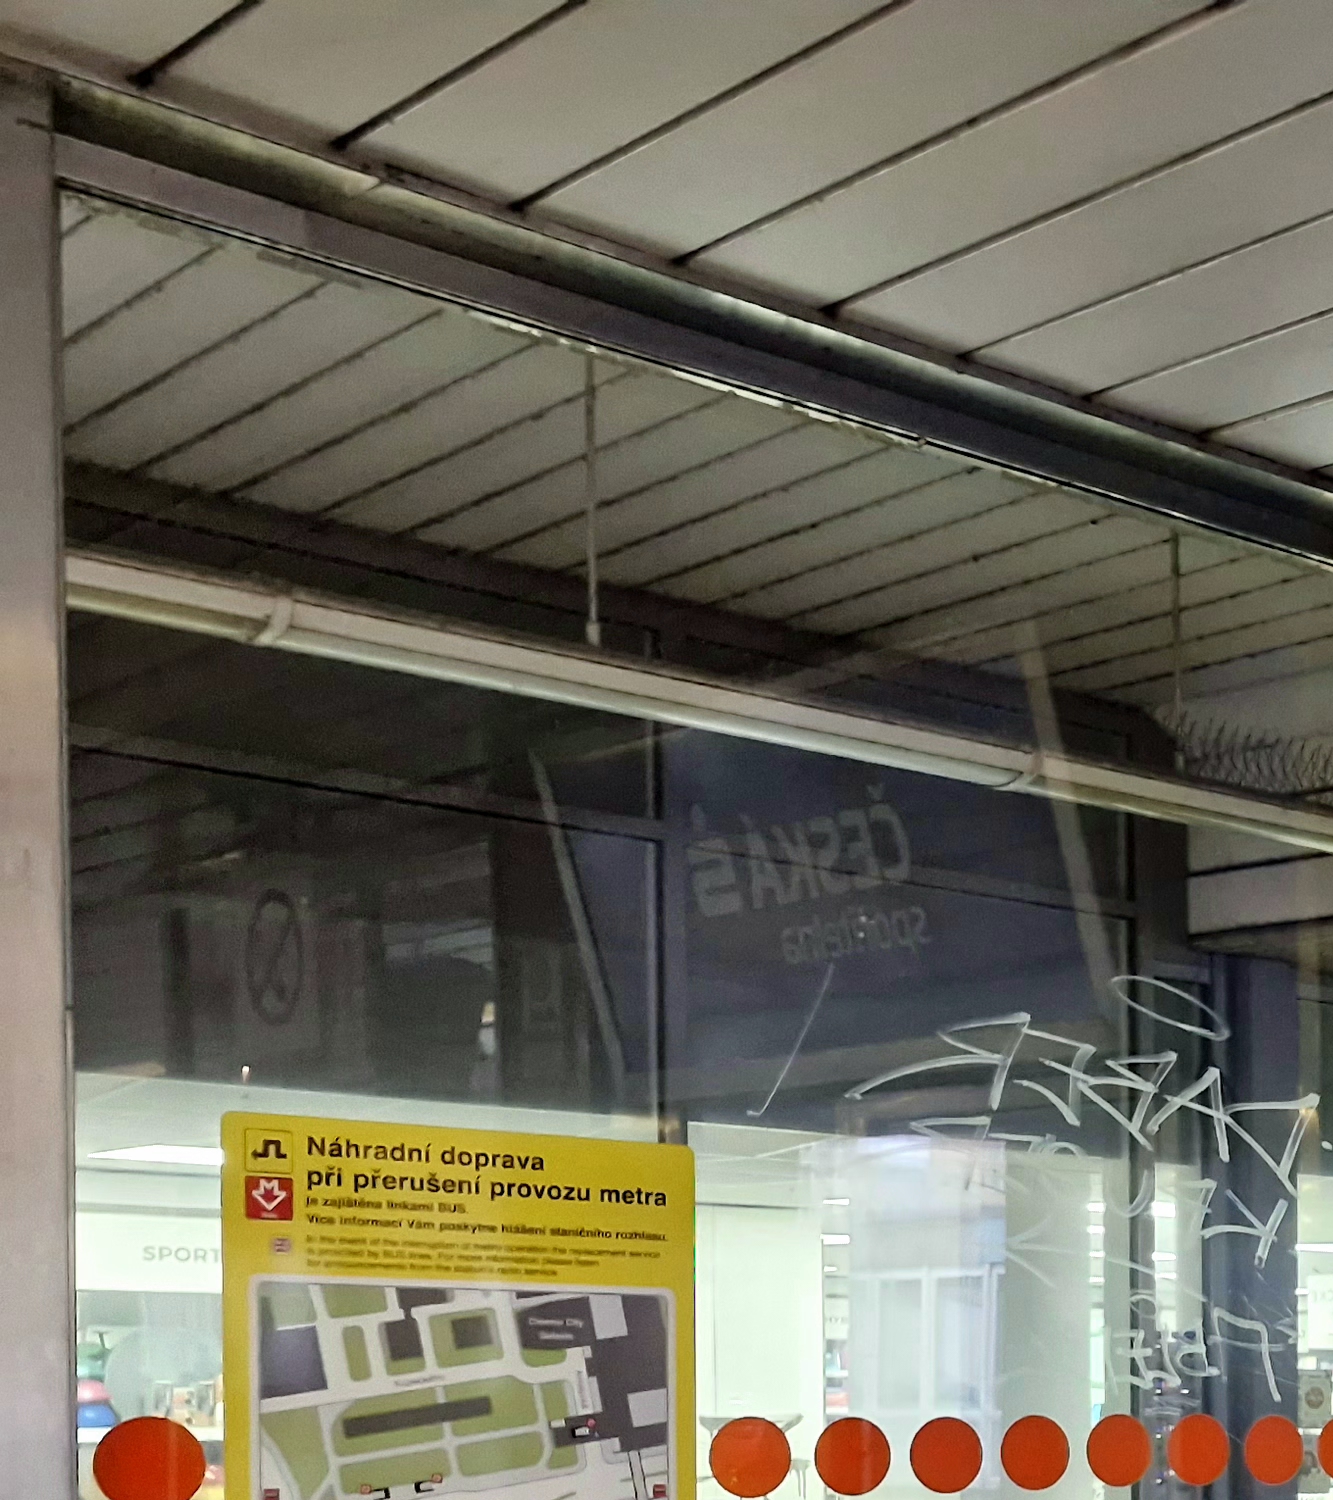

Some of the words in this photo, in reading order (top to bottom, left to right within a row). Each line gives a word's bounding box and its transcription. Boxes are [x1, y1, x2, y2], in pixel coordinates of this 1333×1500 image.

[305, 1136, 432, 1165] Náhradní
[440, 1145, 545, 1173] doprava
[306, 1166, 343, 1191] při
[352, 1172, 482, 1198] přerušení
[489, 1179, 591, 1203] provozu
[599, 1186, 667, 1207] metra
[142, 1245, 221, 1263] SPORT
